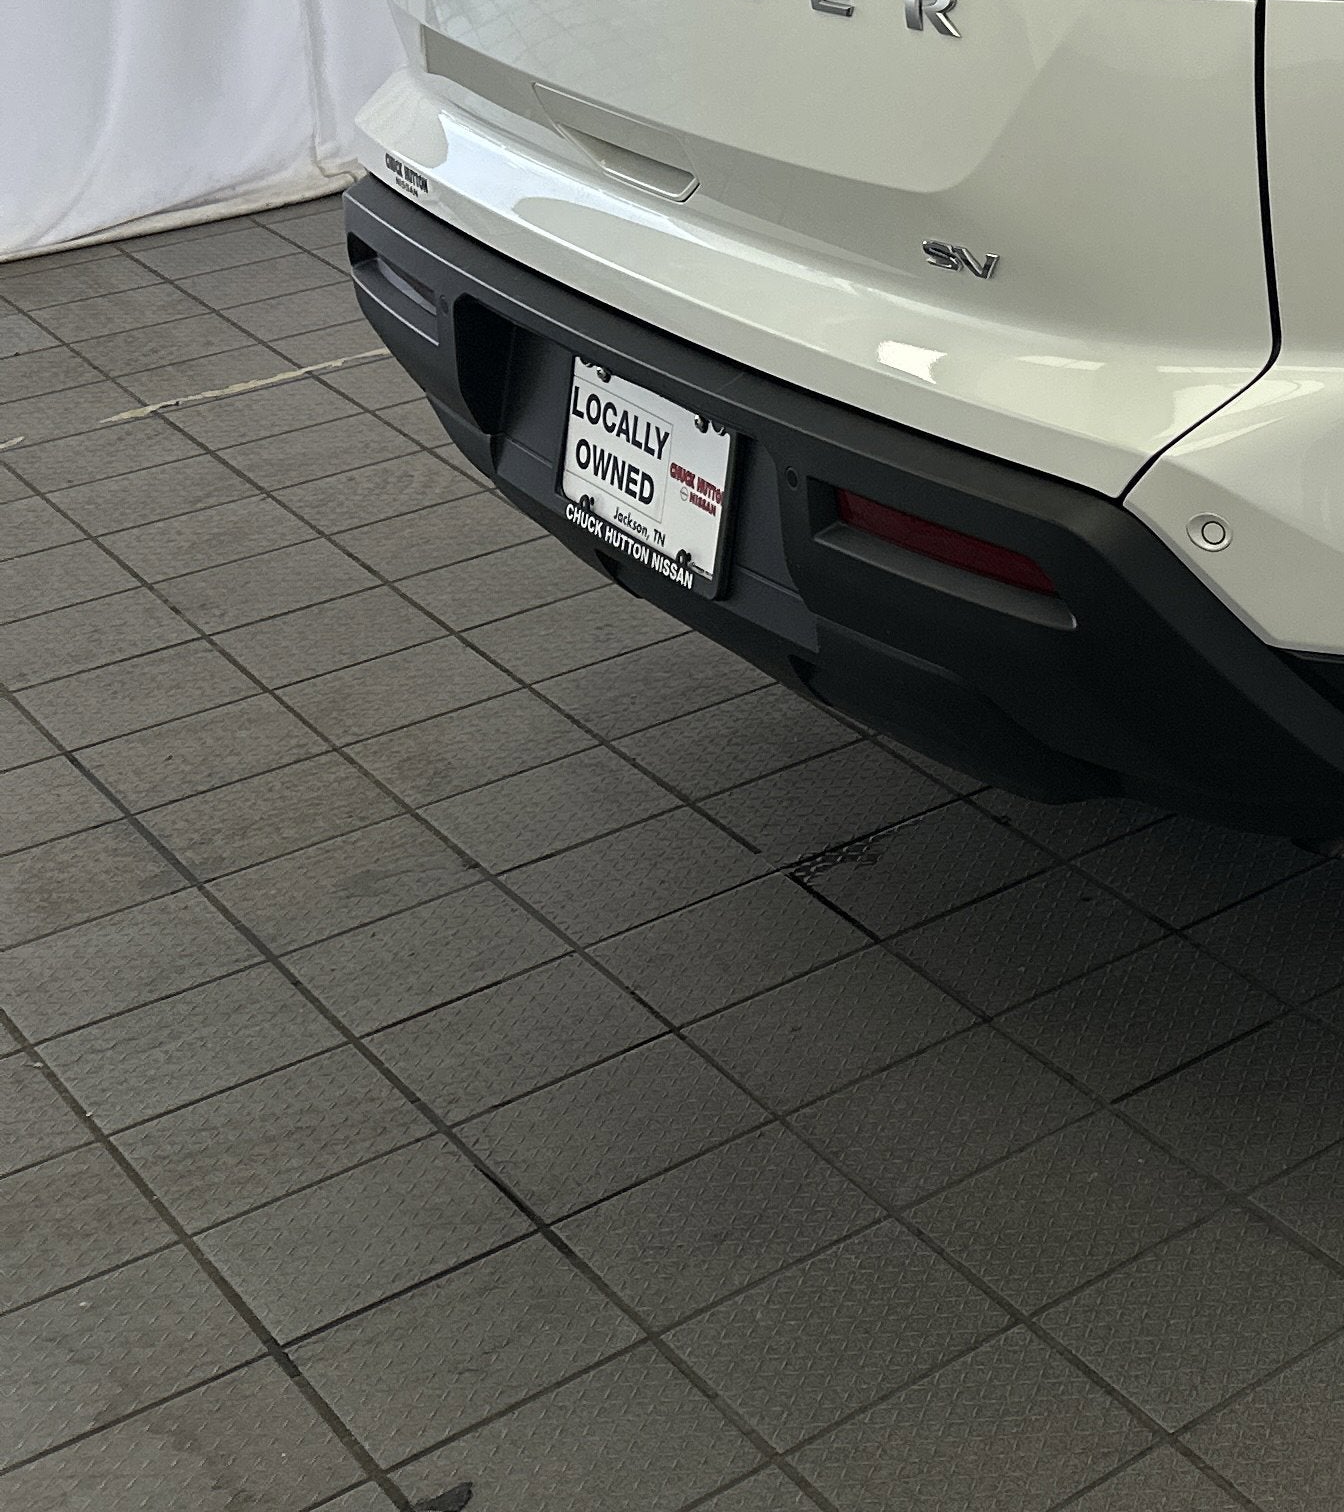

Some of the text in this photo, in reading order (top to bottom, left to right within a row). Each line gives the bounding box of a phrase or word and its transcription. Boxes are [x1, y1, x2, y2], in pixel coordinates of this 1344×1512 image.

[922, 240, 1000, 279] SV
[572, 386, 670, 460] LOCALLY
[575, 438, 655, 505] OWNED
[670, 462, 722, 504] CHUCK HUTTO
[689, 491, 717, 517] NISSAN
[565, 503, 602, 538] CHUCK
[604, 525, 650, 565] HUTTON
[650, 552, 693, 590] NISSAN
[613, 506, 666, 547] Jackson, TN
